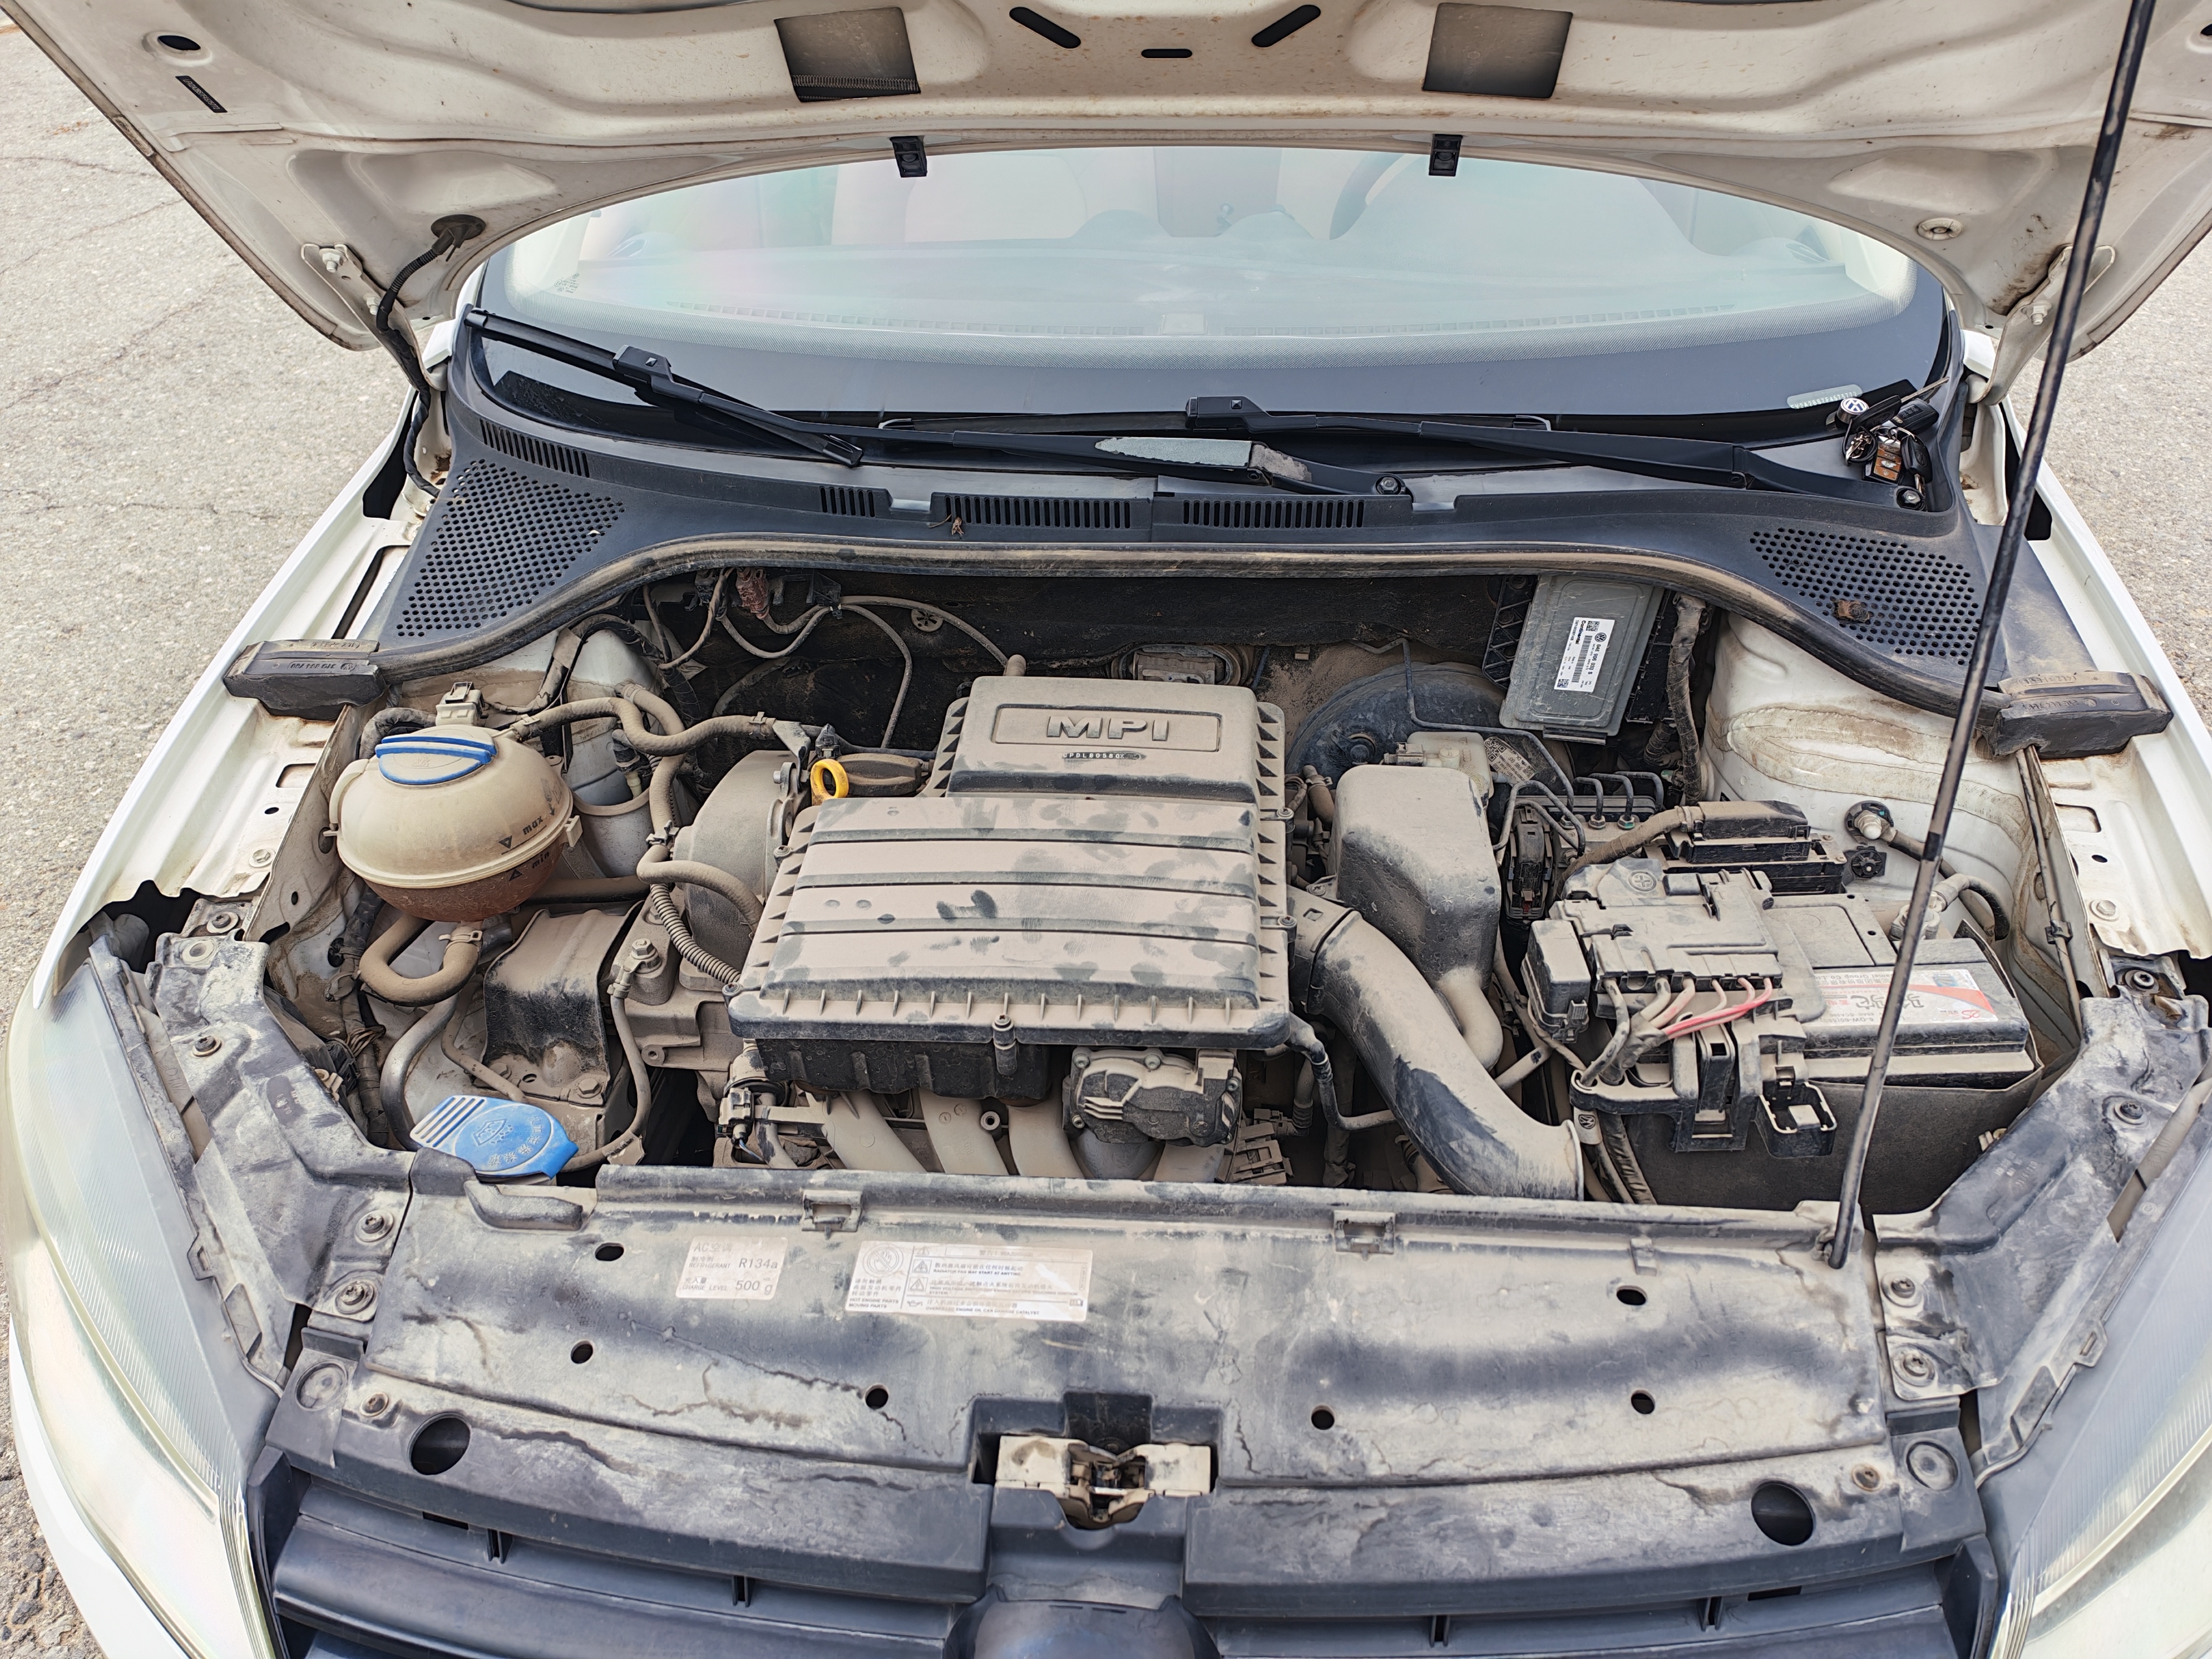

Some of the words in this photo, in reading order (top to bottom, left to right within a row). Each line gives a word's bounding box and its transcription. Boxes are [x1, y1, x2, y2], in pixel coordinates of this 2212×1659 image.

[1575, 620, 1586, 644] Continental
[1047, 716, 1169, 741] MPI
[523, 815, 544, 835] max
[532, 852, 549, 869] min
[739, 1258, 778, 1269] R134a
[735, 1280, 760, 1291] 500
[764, 1284, 773, 1296] g
